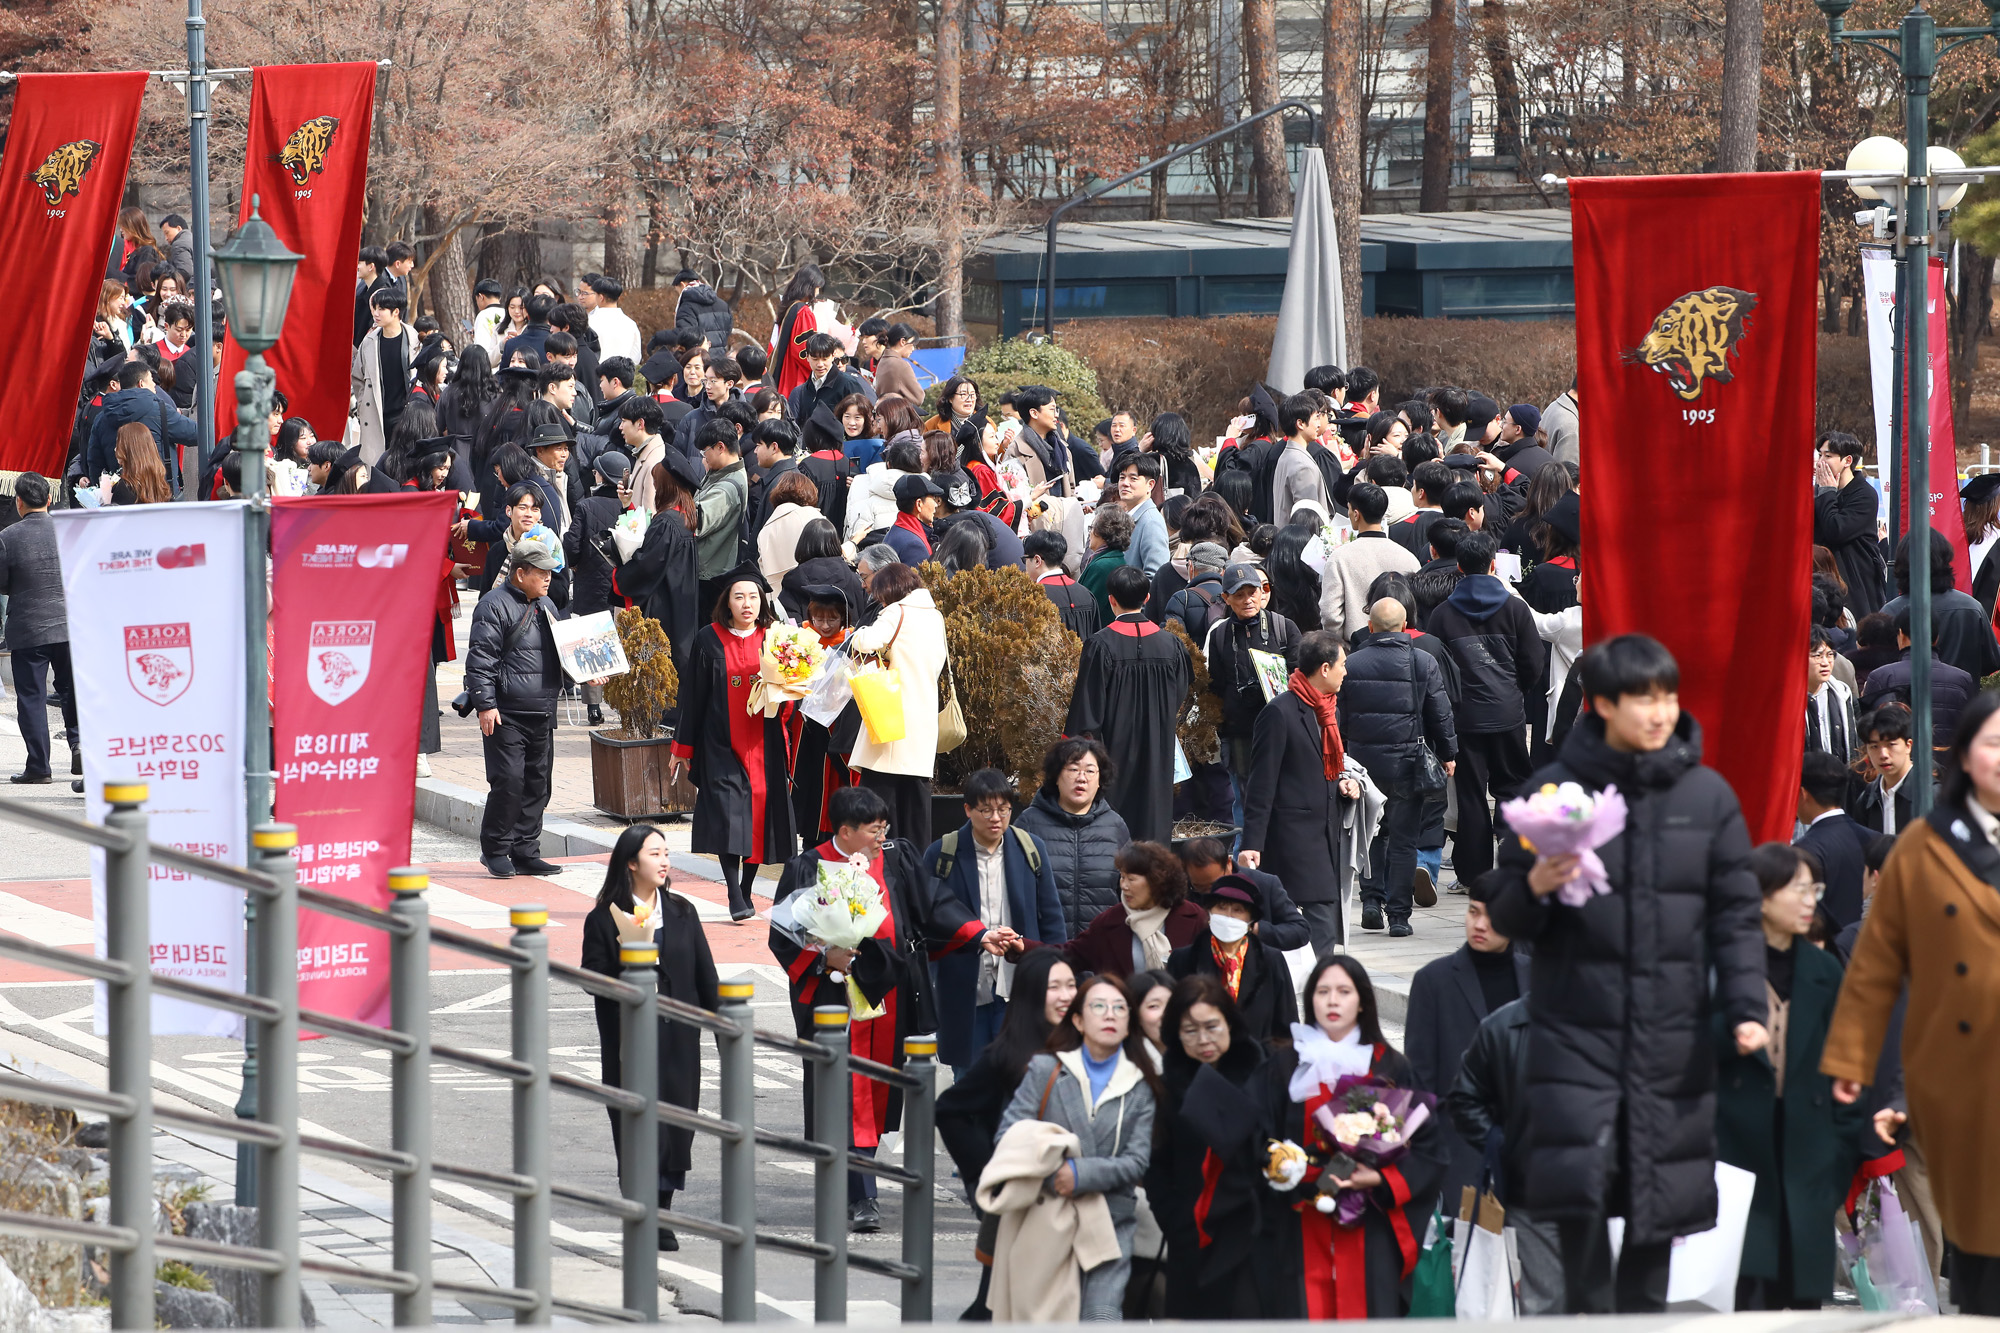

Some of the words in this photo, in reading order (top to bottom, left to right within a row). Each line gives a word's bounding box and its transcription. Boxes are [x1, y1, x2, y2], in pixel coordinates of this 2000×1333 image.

[294, 189, 313, 200] 1905
[47, 209, 66, 219] 1905
[1682, 408, 1716, 426] 1905
